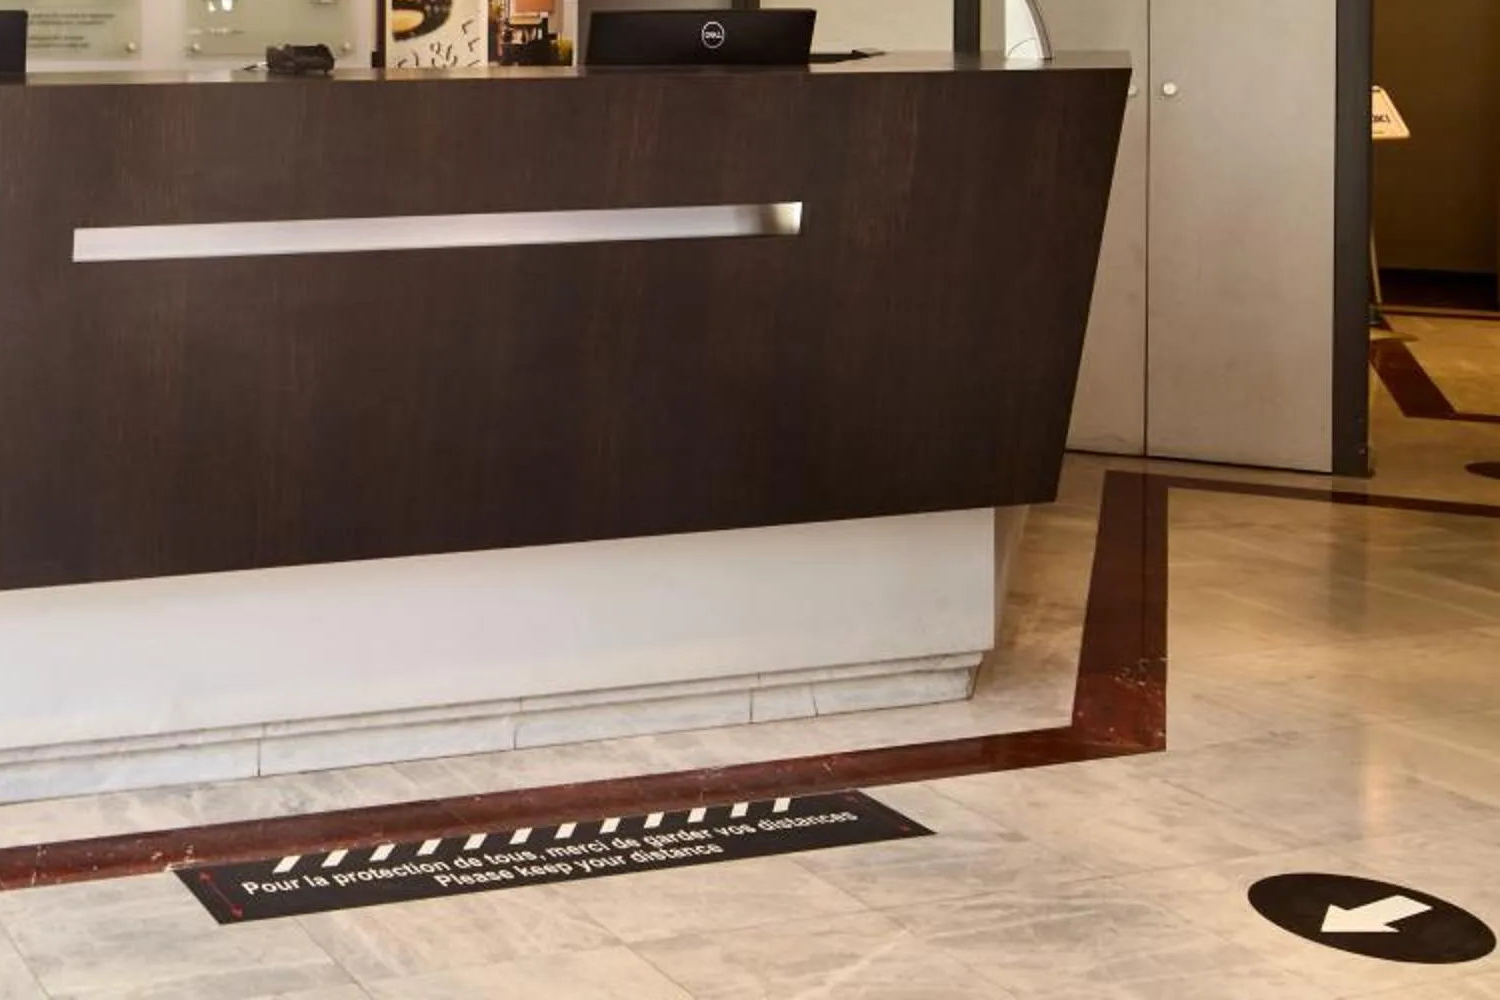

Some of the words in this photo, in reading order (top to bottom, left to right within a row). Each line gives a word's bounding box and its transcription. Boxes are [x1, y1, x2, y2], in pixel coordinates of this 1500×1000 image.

[241, 879, 300, 896] Pour
[307, 875, 330, 888] la
[332, 860, 451, 888] protection
[453, 854, 484, 870] de
[484, 850, 546, 866] tous,
[546, 840, 610, 858] merci
[611, 836, 640, 850] de
[643, 827, 711, 849] garder
[713, 823, 756, 838] vos
[757, 811, 859, 831] distances
[434, 870, 515, 887] Please
[515, 860, 574, 878] keep
[575, 854, 626, 873] your
[630, 843, 724, 862] distance
